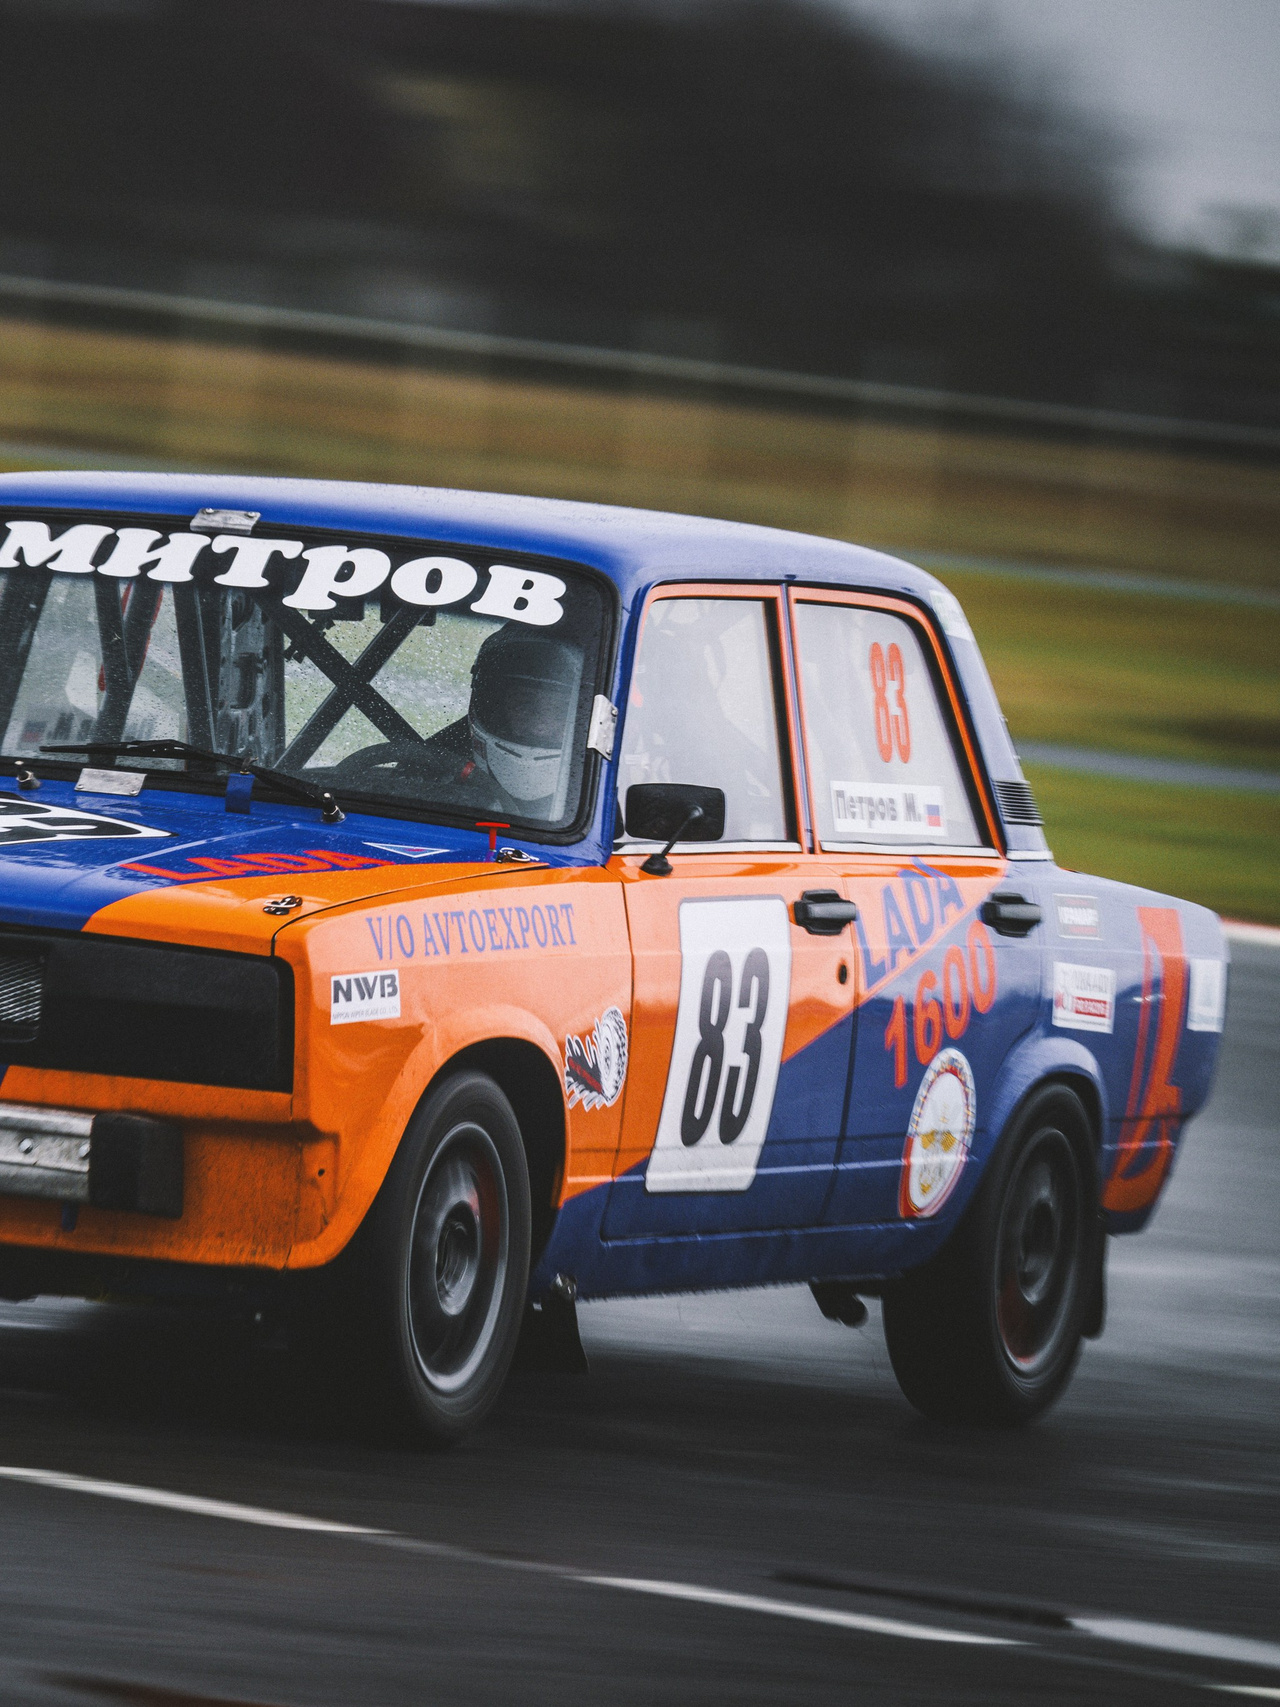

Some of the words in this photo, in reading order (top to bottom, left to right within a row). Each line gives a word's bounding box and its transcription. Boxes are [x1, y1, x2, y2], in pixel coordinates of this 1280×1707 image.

[869, 642, 911, 763] 83
[834, 789, 898, 829] Петров
[118, 849, 396, 881] LADA
[365, 914, 415, 961] V/O
[423, 903, 578, 957] AVTOEXPORT
[854, 856, 965, 989] LADA
[333, 974, 399, 1004] NWB
[885, 919, 997, 1089] 1600
[680, 946, 770, 1147] 83
